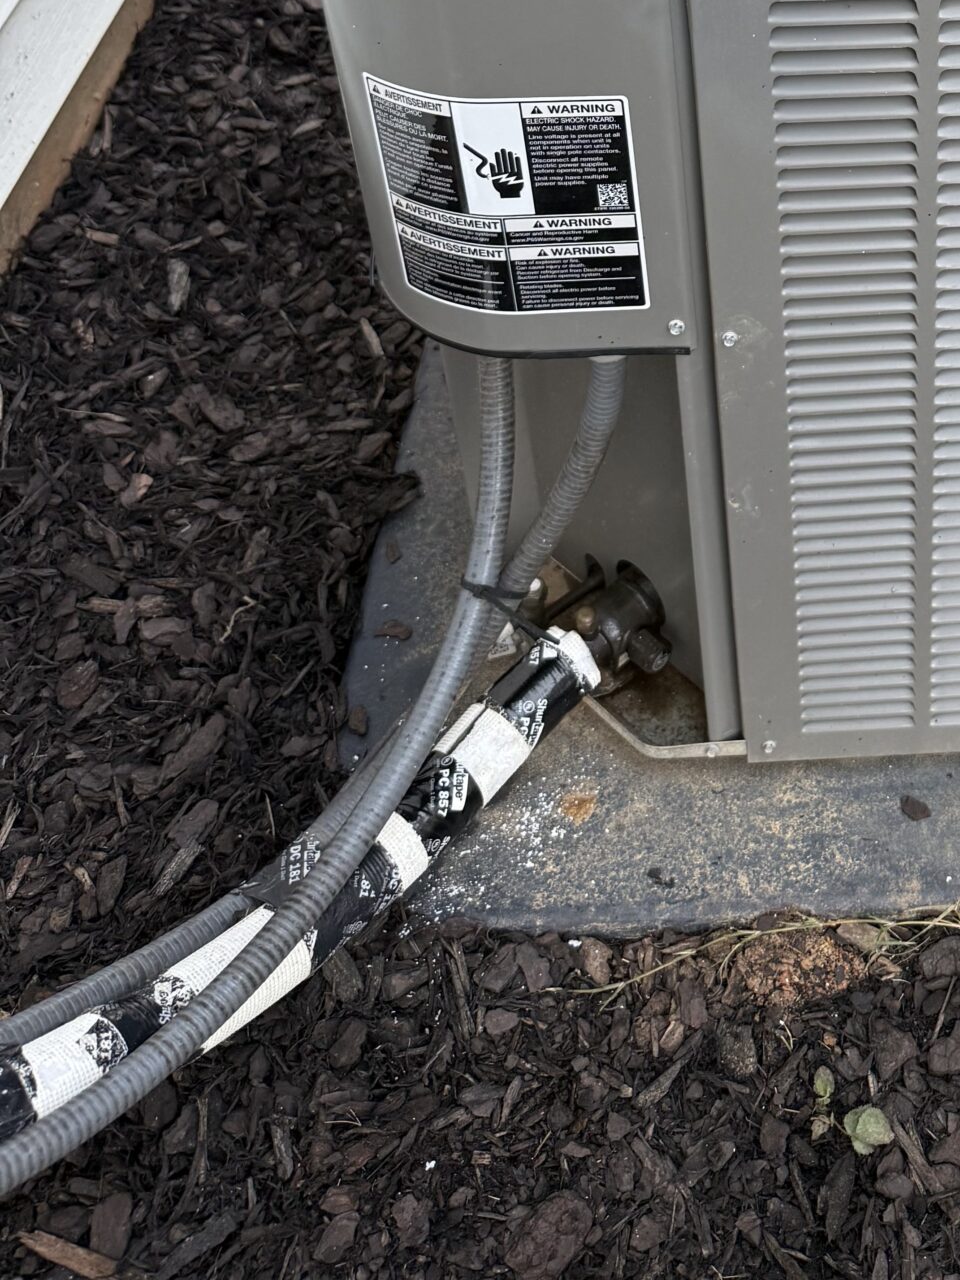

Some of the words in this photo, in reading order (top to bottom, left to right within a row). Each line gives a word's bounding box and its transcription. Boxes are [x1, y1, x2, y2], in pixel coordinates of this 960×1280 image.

[385, 89, 442, 112] AVERTISSEMENT
[546, 104, 616, 114] WARNING
[405, 202, 500, 230] AVERTISSEMENT
[547, 218, 612, 228] WARNING
[410, 231, 504, 258] AVERTISSEMENT
[551, 246, 616, 256] WARNING
[439, 769, 450, 788] PC
[455, 761, 466, 800] urtape
[438, 790, 450, 818] 857
[290, 845, 302, 861] DC
[288, 864, 300, 886] 181
[359, 873, 371, 898] 81
